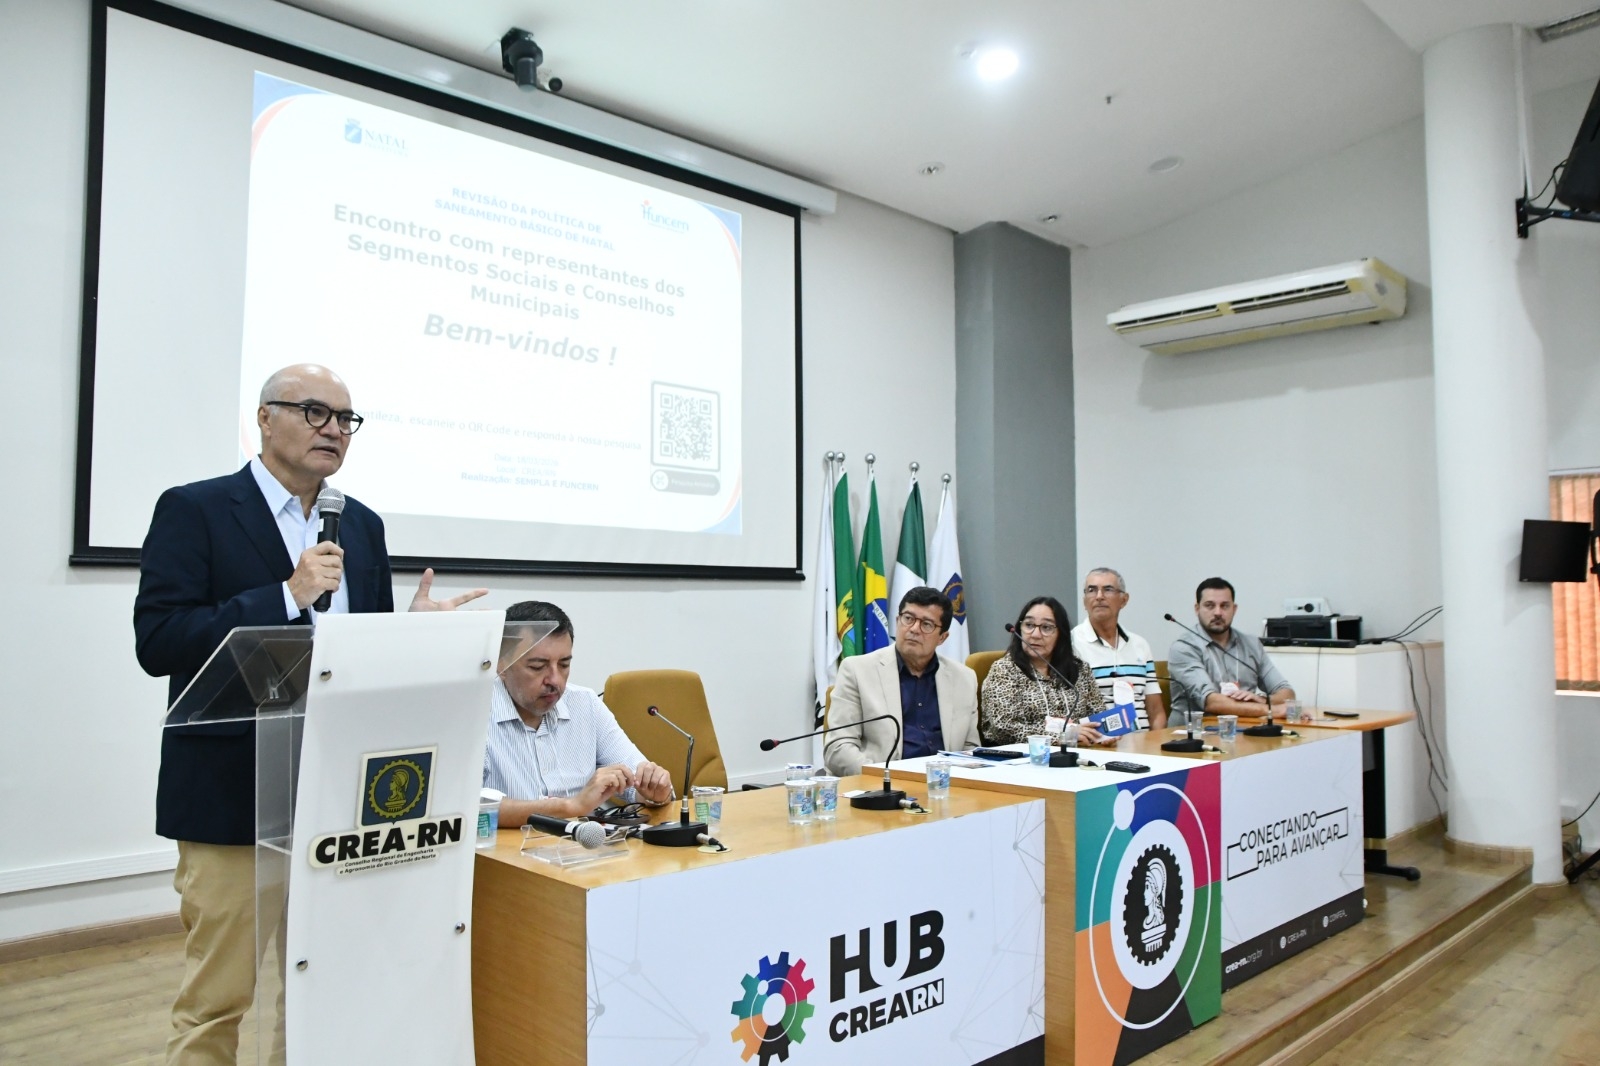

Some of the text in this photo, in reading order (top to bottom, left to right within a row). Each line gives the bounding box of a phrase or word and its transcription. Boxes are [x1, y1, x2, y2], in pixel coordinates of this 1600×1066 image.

[434, 198, 616, 251] SANEAMENTO BÁSICO DE NATAL
[452, 187, 602, 233] REVISÃO DA POLÍTICA DE
[333, 203, 685, 298] Encontro com representantes dos
[347, 233, 675, 317] Segmentos Sociais e Conselhos
[470, 284, 580, 321] Municipais
[423, 313, 617, 367] Bem-vindos !
[355, 410, 403, 424] entileza,
[409, 416, 455, 429] escaneie
[459, 422, 465, 430] o
[468, 421, 483, 433] QR
[486, 423, 511, 435] Code
[514, 428, 520, 437] e
[522, 429, 566, 441] responda
[577, 435, 601, 446] nossa
[604, 439, 642, 450] pesquisa
[461, 471, 599, 491] Realização: SEMPLA E FUNCERN
[315, 817, 462, 865] CREA-RN
[1239, 810, 1317, 852] CONECTANDO
[1257, 823, 1340, 868] PARA AVANÇAR
[344, 863, 376, 873] Agronomia
[394, 857, 413, 865] Grande
[345, 859, 371, 867] Conselho
[372, 854, 395, 863] Regional
[404, 848, 434, 858] Engenharia
[829, 909, 945, 1003] HUB
